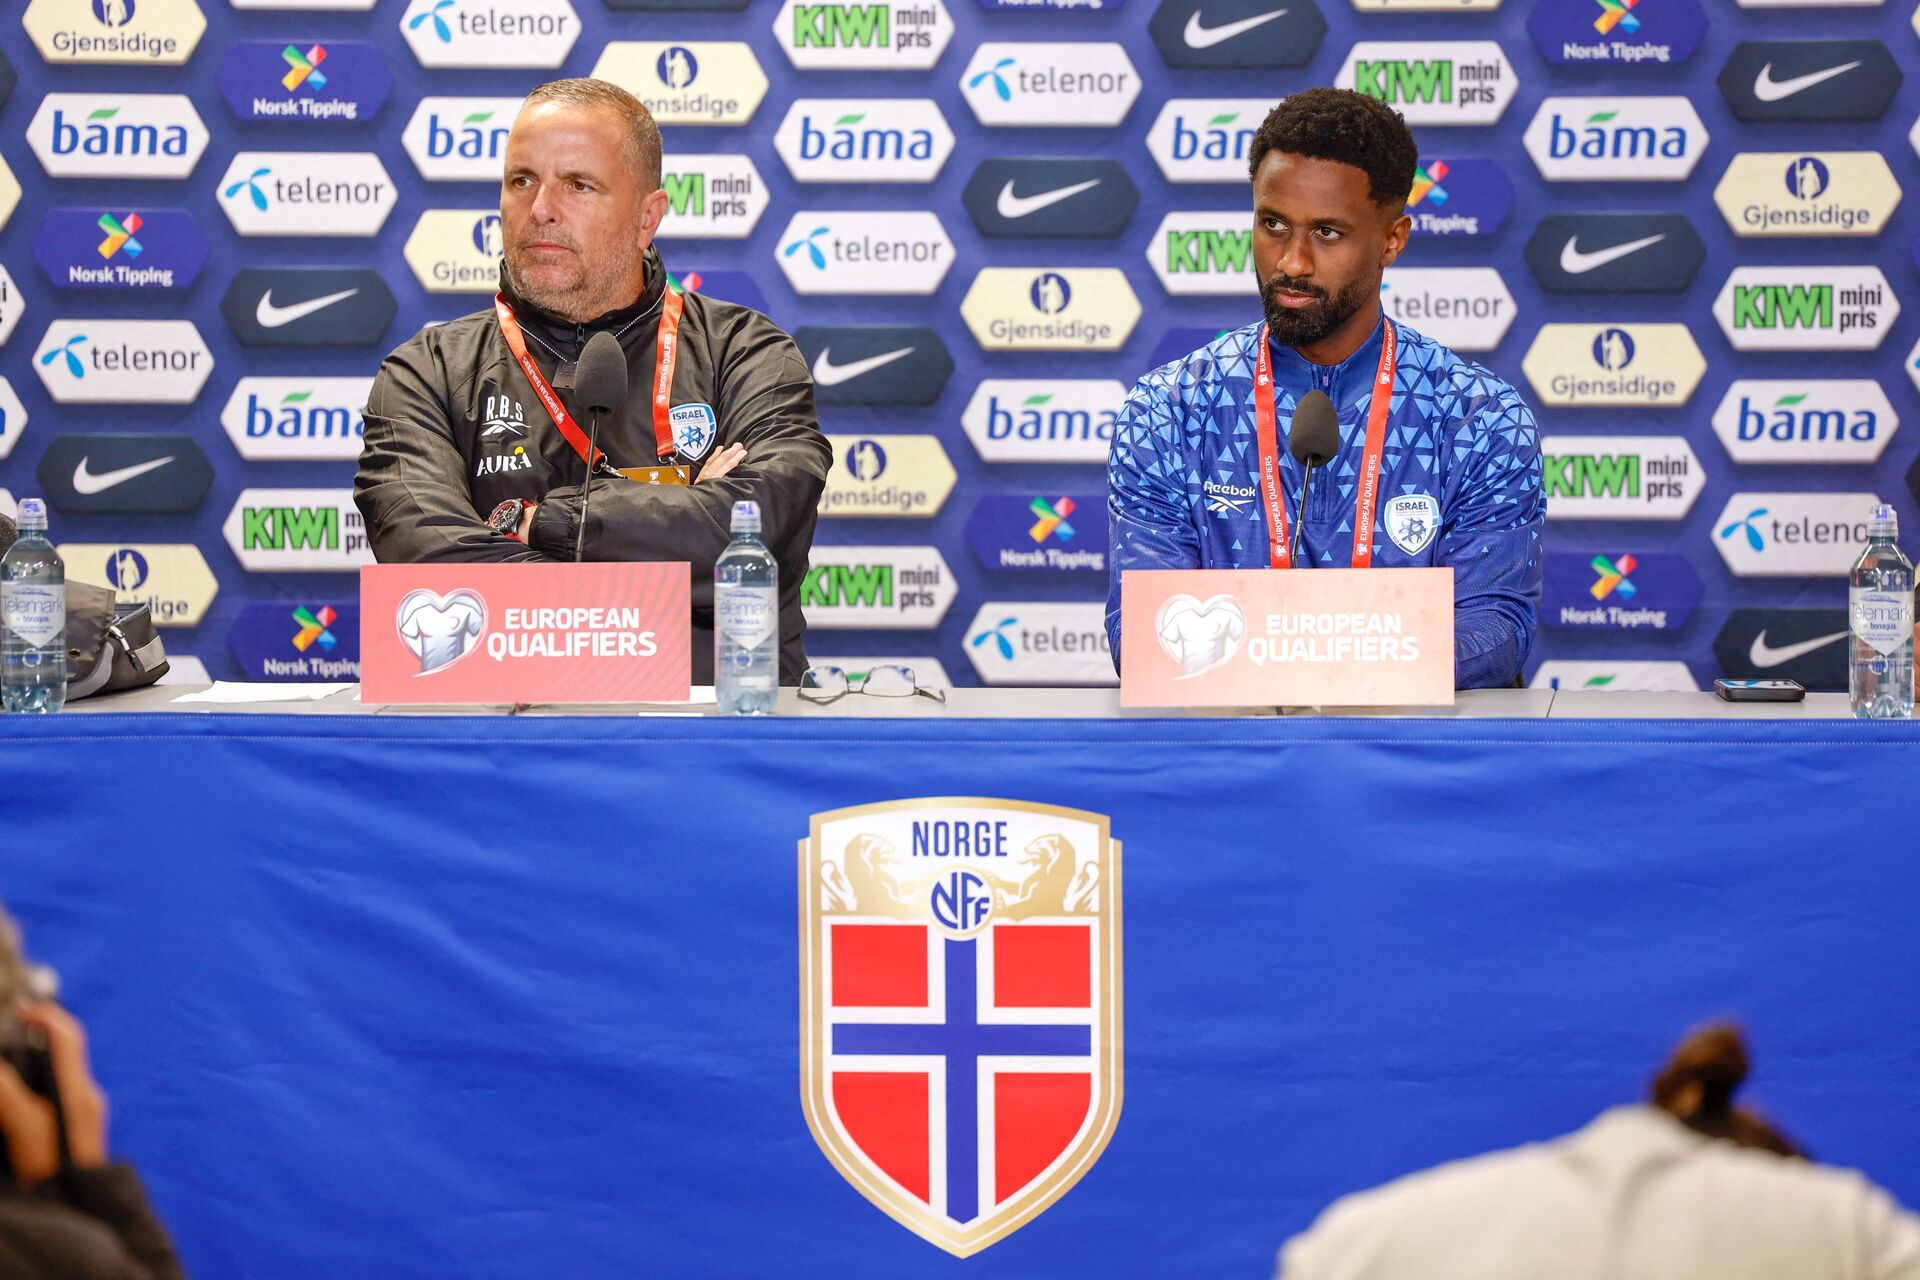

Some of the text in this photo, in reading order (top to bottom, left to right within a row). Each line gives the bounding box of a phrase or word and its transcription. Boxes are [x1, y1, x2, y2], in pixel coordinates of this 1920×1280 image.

[459, 9, 567, 35] telenor
[793, 4, 890, 48] KIWI
[896, 6, 937, 25] mini
[53, 31, 177, 57] Gjensidige
[896, 28, 932, 52] pris
[1563, 43, 1670, 62] Norsk Tipping
[1019, 68, 1128, 93] telenor
[1355, 60, 1452, 103] KIWI
[1459, 60, 1500, 80] mini
[644, 95, 738, 118] ensidige
[1460, 82, 1494, 107] pris
[253, 99, 357, 119] Norsk Tipping
[52, 110, 188, 156] bama
[800, 117, 933, 160] bama
[1549, 114, 1687, 158] bama
[275, 177, 384, 204] telenor
[661, 172, 705, 216] WI
[711, 174, 751, 194] mini
[712, 196, 747, 221] pris
[1743, 205, 1871, 230] Gjensidige
[1419, 213, 1478, 235] Tipping
[834, 236, 941, 261] telenor
[1168, 231, 1254, 273] KIW
[69, 266, 173, 287] Norsk Tipping
[1393, 291, 1503, 318] telenor
[1733, 285, 1833, 328] KIWI
[1839, 285, 1882, 306] mini
[989, 319, 1111, 345] Gjensidige
[1839, 308, 1876, 333] pris
[91, 344, 200, 370] telenor
[1551, 375, 1676, 400] Gjensidige
[486, 395, 523, 421] R.B.S
[672, 410, 704, 420] ISRAEL
[1737, 397, 1876, 442] bama
[476, 451, 532, 477] AURA
[1543, 455, 1640, 497] KIWI
[1646, 456, 1688, 476] mini
[823, 486, 926, 511] jensidige
[1204, 481, 1256, 497] Reebok
[1264, 455, 1284, 543] EUROPEAN QUALIFIERS
[1360, 454, 1377, 541] EUROPEAN QUALIFIERS
[1646, 478, 1682, 502] pris
[1395, 501, 1429, 511] ISRAEL
[243, 507, 339, 550] KIWI
[1772, 516, 1868, 543] teleno
[1000, 549, 1104, 571] Norsk Tipping
[800, 565, 893, 607] KIWI
[900, 565, 940, 585] mini
[900, 588, 934, 613] pris
[1851, 602, 1912, 621] Telemark
[505, 607, 639, 630] EUROPEAN
[1266, 612, 1401, 636] EUROPEAN
[1561, 607, 1666, 628] Norsk Tipping
[487, 631, 657, 661] QUALIFIERS
[1248, 636, 1419, 666] QUALIFIERS
[264, 658, 308, 675] Norsk
[912, 820, 1007, 857] NORGE
